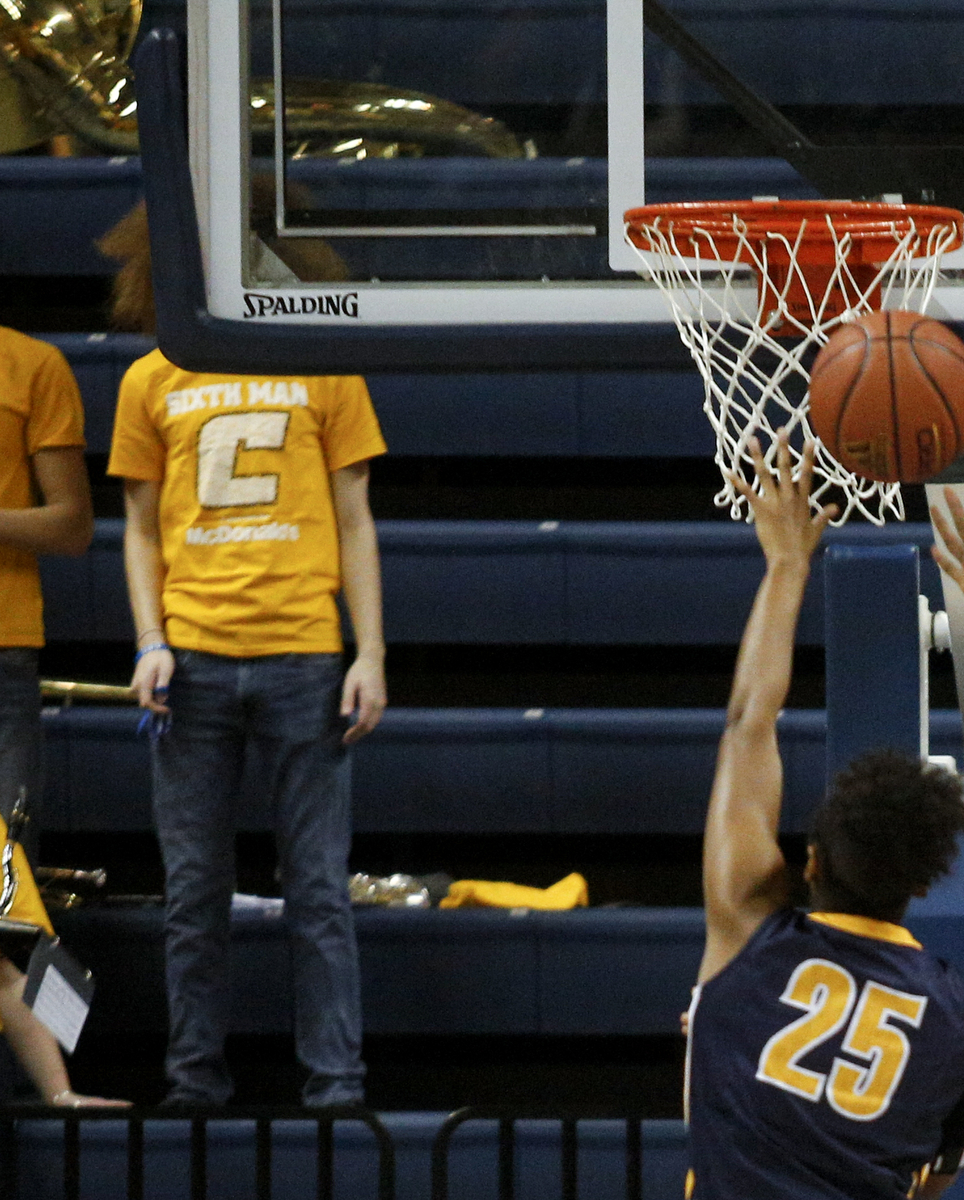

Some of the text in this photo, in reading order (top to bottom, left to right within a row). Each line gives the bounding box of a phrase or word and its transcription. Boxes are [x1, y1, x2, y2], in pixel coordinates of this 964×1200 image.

[243, 291, 359, 319] SPALDING
[247, 381, 309, 408] MAN
[196, 409, 292, 511] C
[755, 957, 928, 1122] 25
